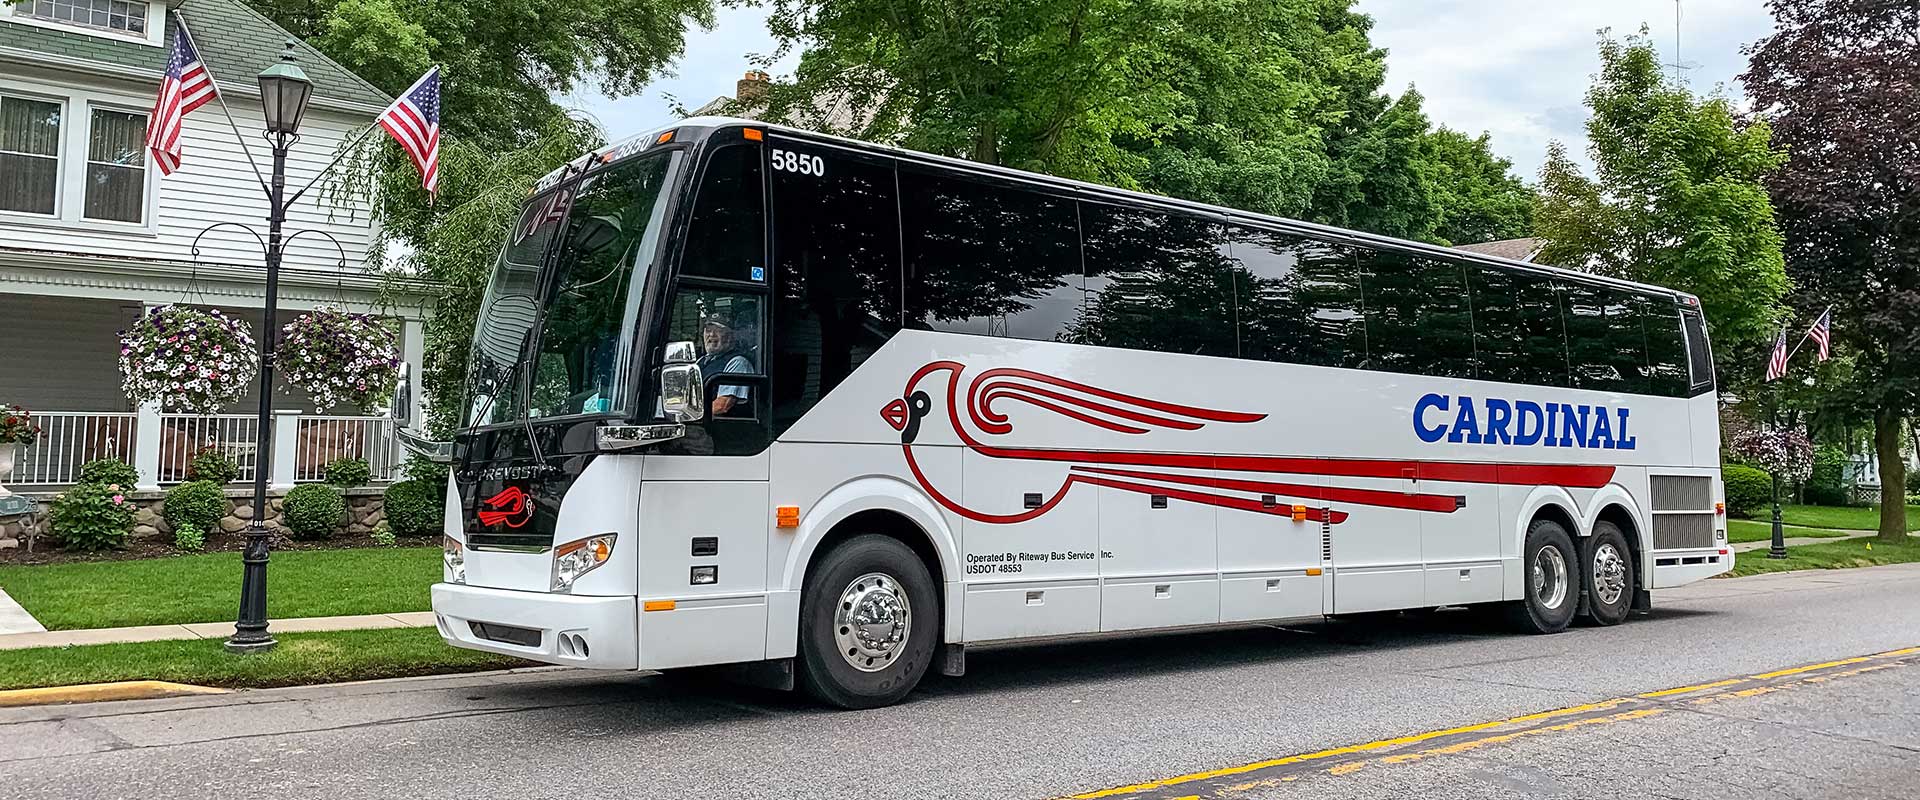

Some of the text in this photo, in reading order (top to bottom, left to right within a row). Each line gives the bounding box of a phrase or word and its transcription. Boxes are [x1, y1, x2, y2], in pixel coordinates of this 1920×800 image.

[615, 135, 653, 159] 5850
[772, 149, 825, 177] 5850
[1413, 393, 1636, 450] CARDINAL
[478, 465, 539, 481] PREVOST
[966, 550, 1114, 564] Operated By Riteway Bus Service Inc.
[966, 563, 1022, 574] USDOT 48553
